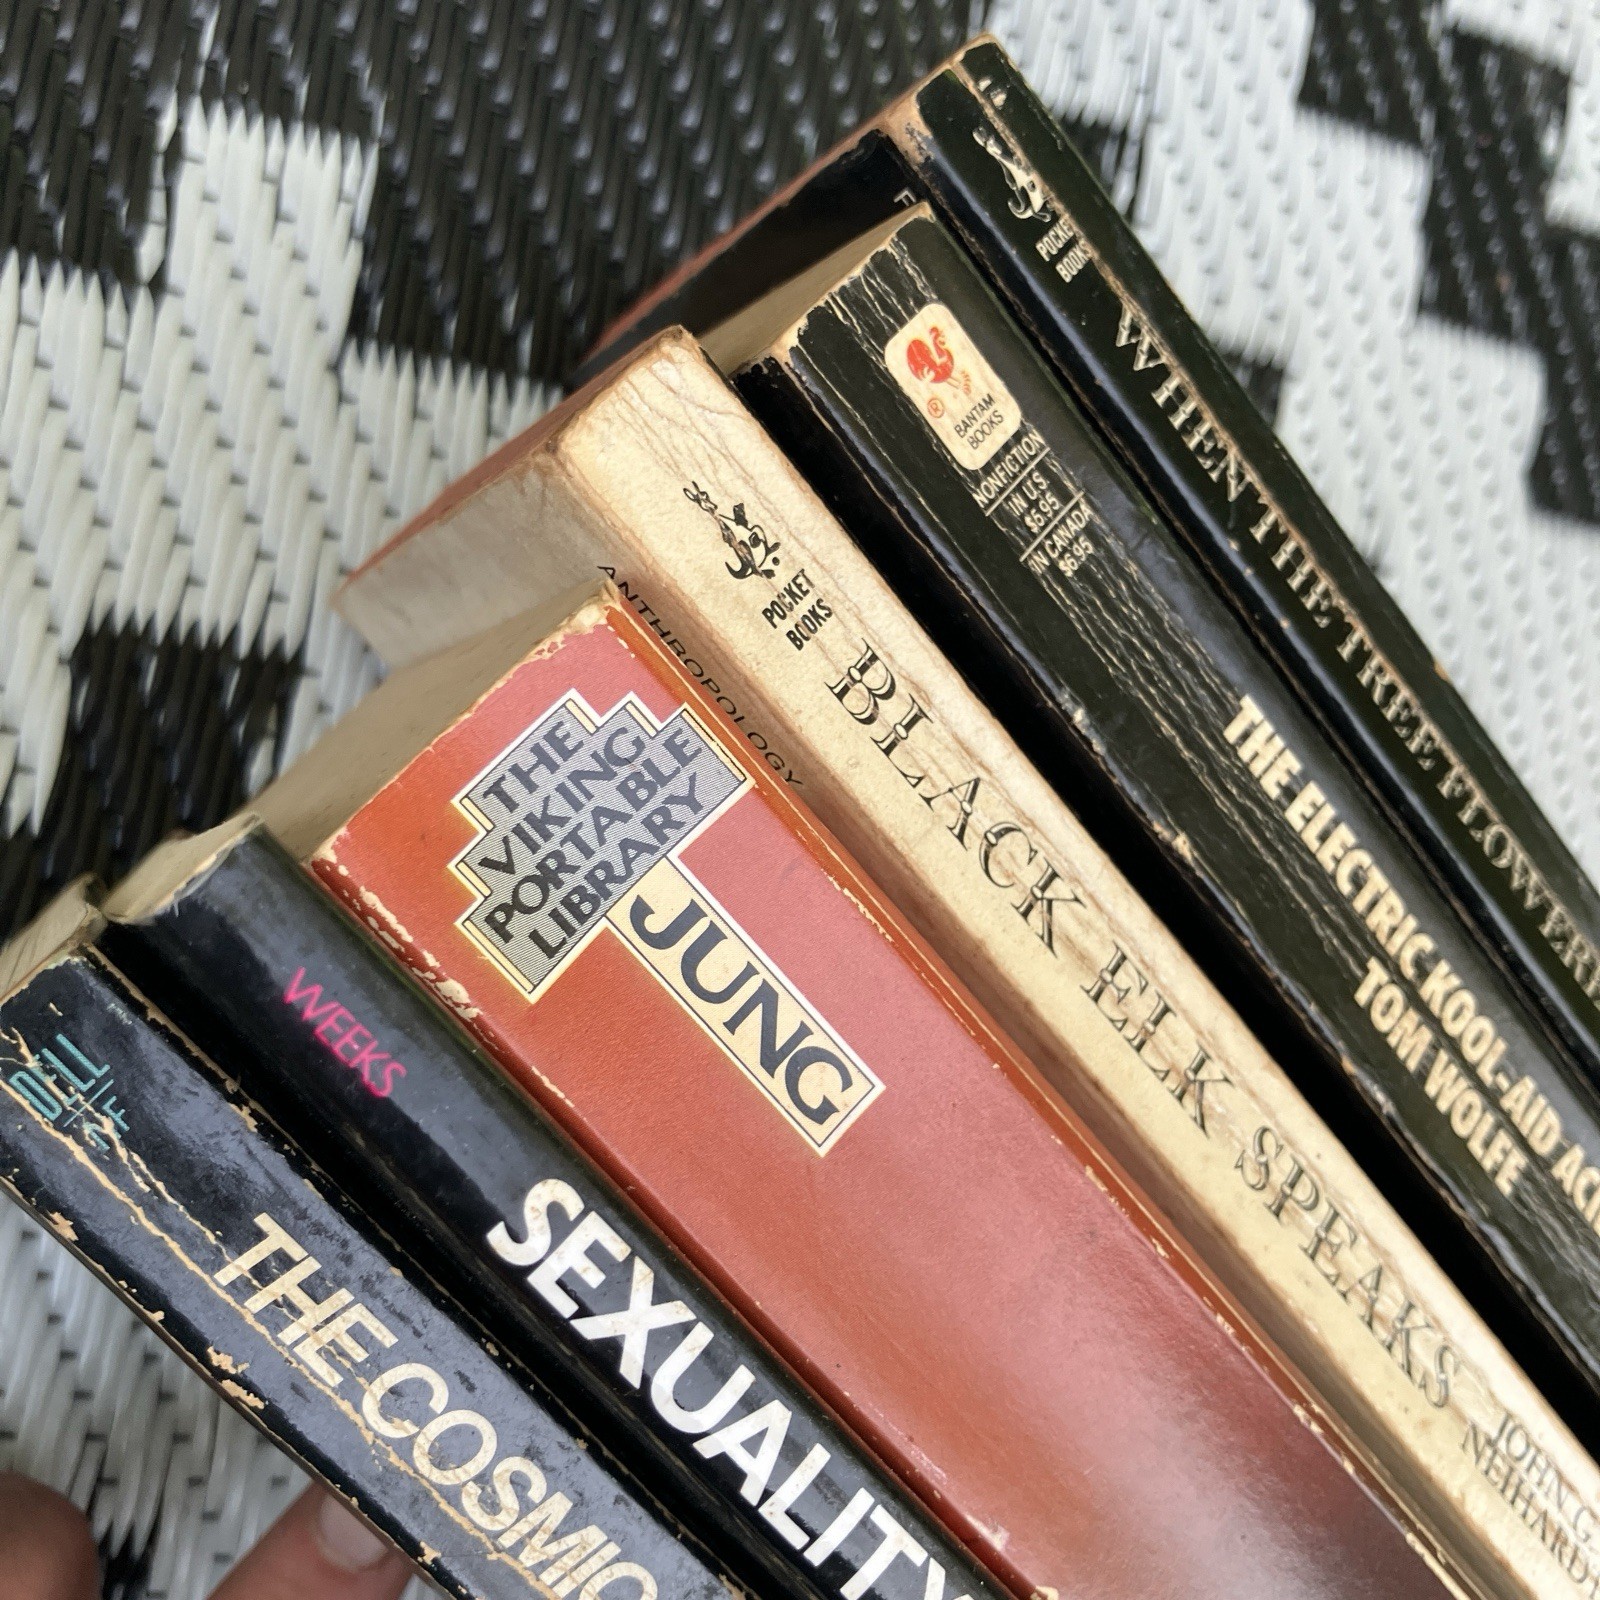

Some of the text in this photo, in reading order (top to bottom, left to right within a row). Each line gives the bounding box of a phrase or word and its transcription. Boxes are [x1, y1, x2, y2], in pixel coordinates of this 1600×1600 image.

[953, 393, 996, 439] BANTAM
[966, 410, 1004, 450] BOOKS
[972, 428, 1046, 509] NONFICTION
[1008, 492, 1028, 516] IN
[1028, 502, 1093, 575] IN CANADA
[1058, 535, 1094, 577] $6.95
[1115, 302, 1253, 502] WHEN
[1250, 498, 1340, 629] THE
[1337, 617, 1440, 771] TREE
[762, 568, 815, 629] POCKET
[786, 598, 832, 651] BOOKS
[479, 727, 646, 875] VIKING
[483, 720, 584, 814] THE
[484, 728, 701, 944] PORTABLE
[530, 773, 704, 959] LIBRARY
[1223, 694, 1303, 801] THE
[1284, 780, 1435, 981] ELECTRIC
[1420, 959, 1561, 1157] KOOL-AID
[283, 966, 407, 1097] WEEKS
[630, 894, 853, 1125] JUNG
[825, 638, 1459, 1408] BLACK ELK SPEAKS
[9, 1034, 110, 1121] DELL
[1354, 956, 1528, 1196] TOM WOLFE
[214, 1212, 398, 1387] THE
[1487, 1412, 1569, 1513] JOHN
